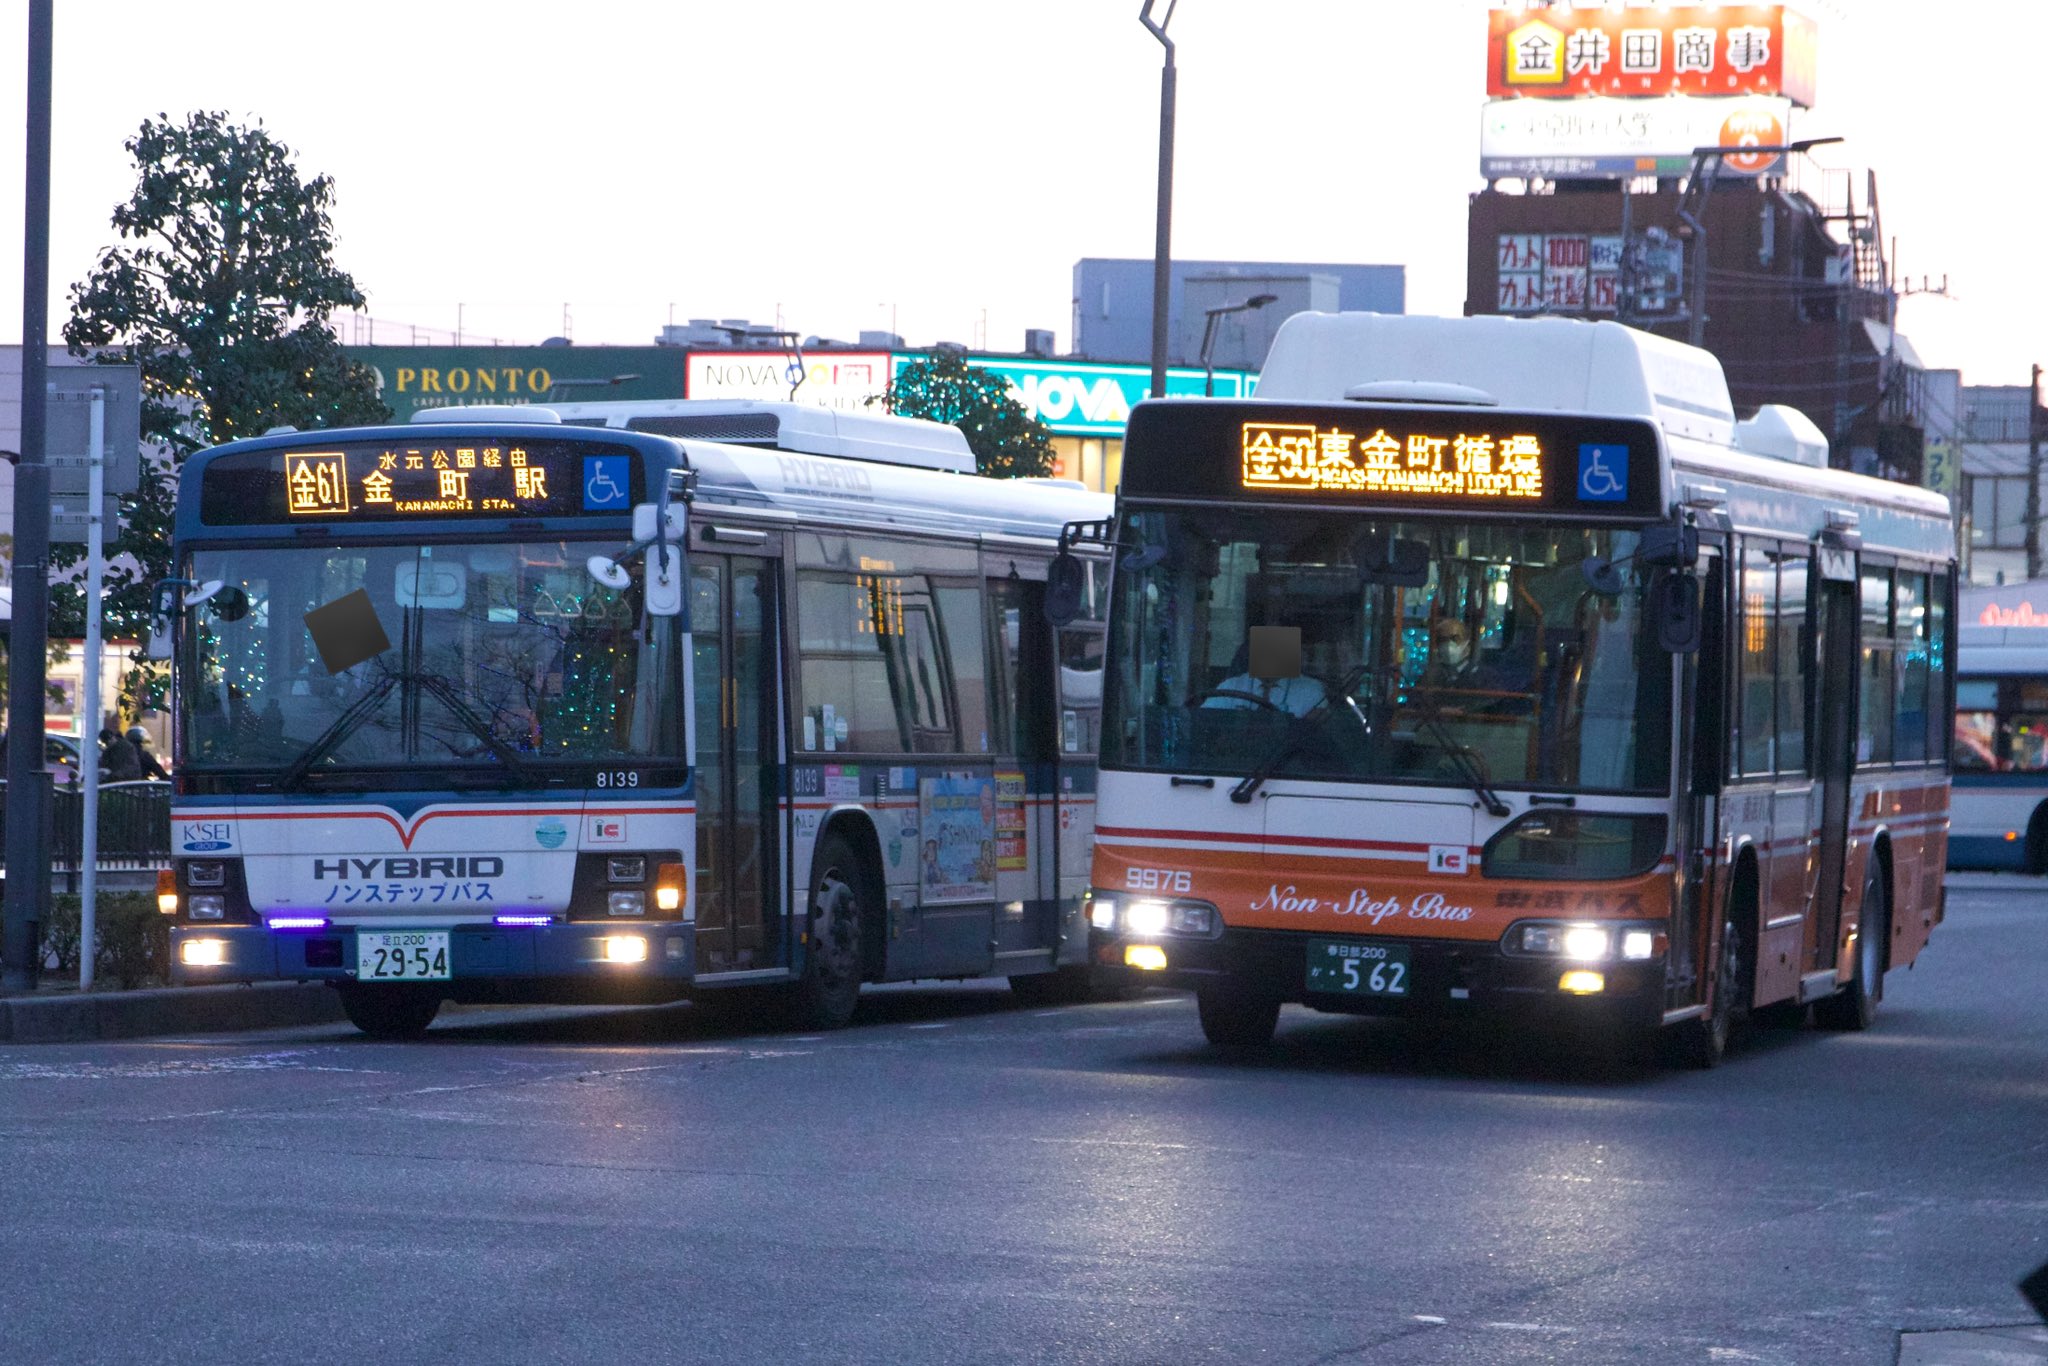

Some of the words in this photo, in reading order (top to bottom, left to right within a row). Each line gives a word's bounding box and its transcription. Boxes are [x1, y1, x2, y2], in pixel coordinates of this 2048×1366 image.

[1518, 28, 1772, 73] 金井田商事
[1582, 75, 1769, 90] KANAIDA
[396, 367, 551, 393] PRONTO
[706, 364, 778, 385] NOVA
[1004, 374, 1131, 422] NOVA
[379, 447, 528, 471] 水元公園経由
[1250, 431, 1316, 480] 金50
[1317, 428, 1542, 474] 東金町循環
[291, 459, 341, 508] 金61
[362, 467, 548, 503] 金町駅
[776, 456, 872, 491] HYBRID
[395, 500, 473, 512] KANAMACHI
[482, 499, 516, 510] STA.
[597, 771, 638, 788] 8139
[794, 768, 817, 793] 8139
[314, 856, 504, 880] HYBRID
[1126, 867, 1192, 892] 9976
[325, 881, 494, 904] ノンステップバス
[1251, 884, 1402, 925] Non-Step
[1407, 893, 1475, 921] Bus
[374, 947, 447, 977] 29-54
